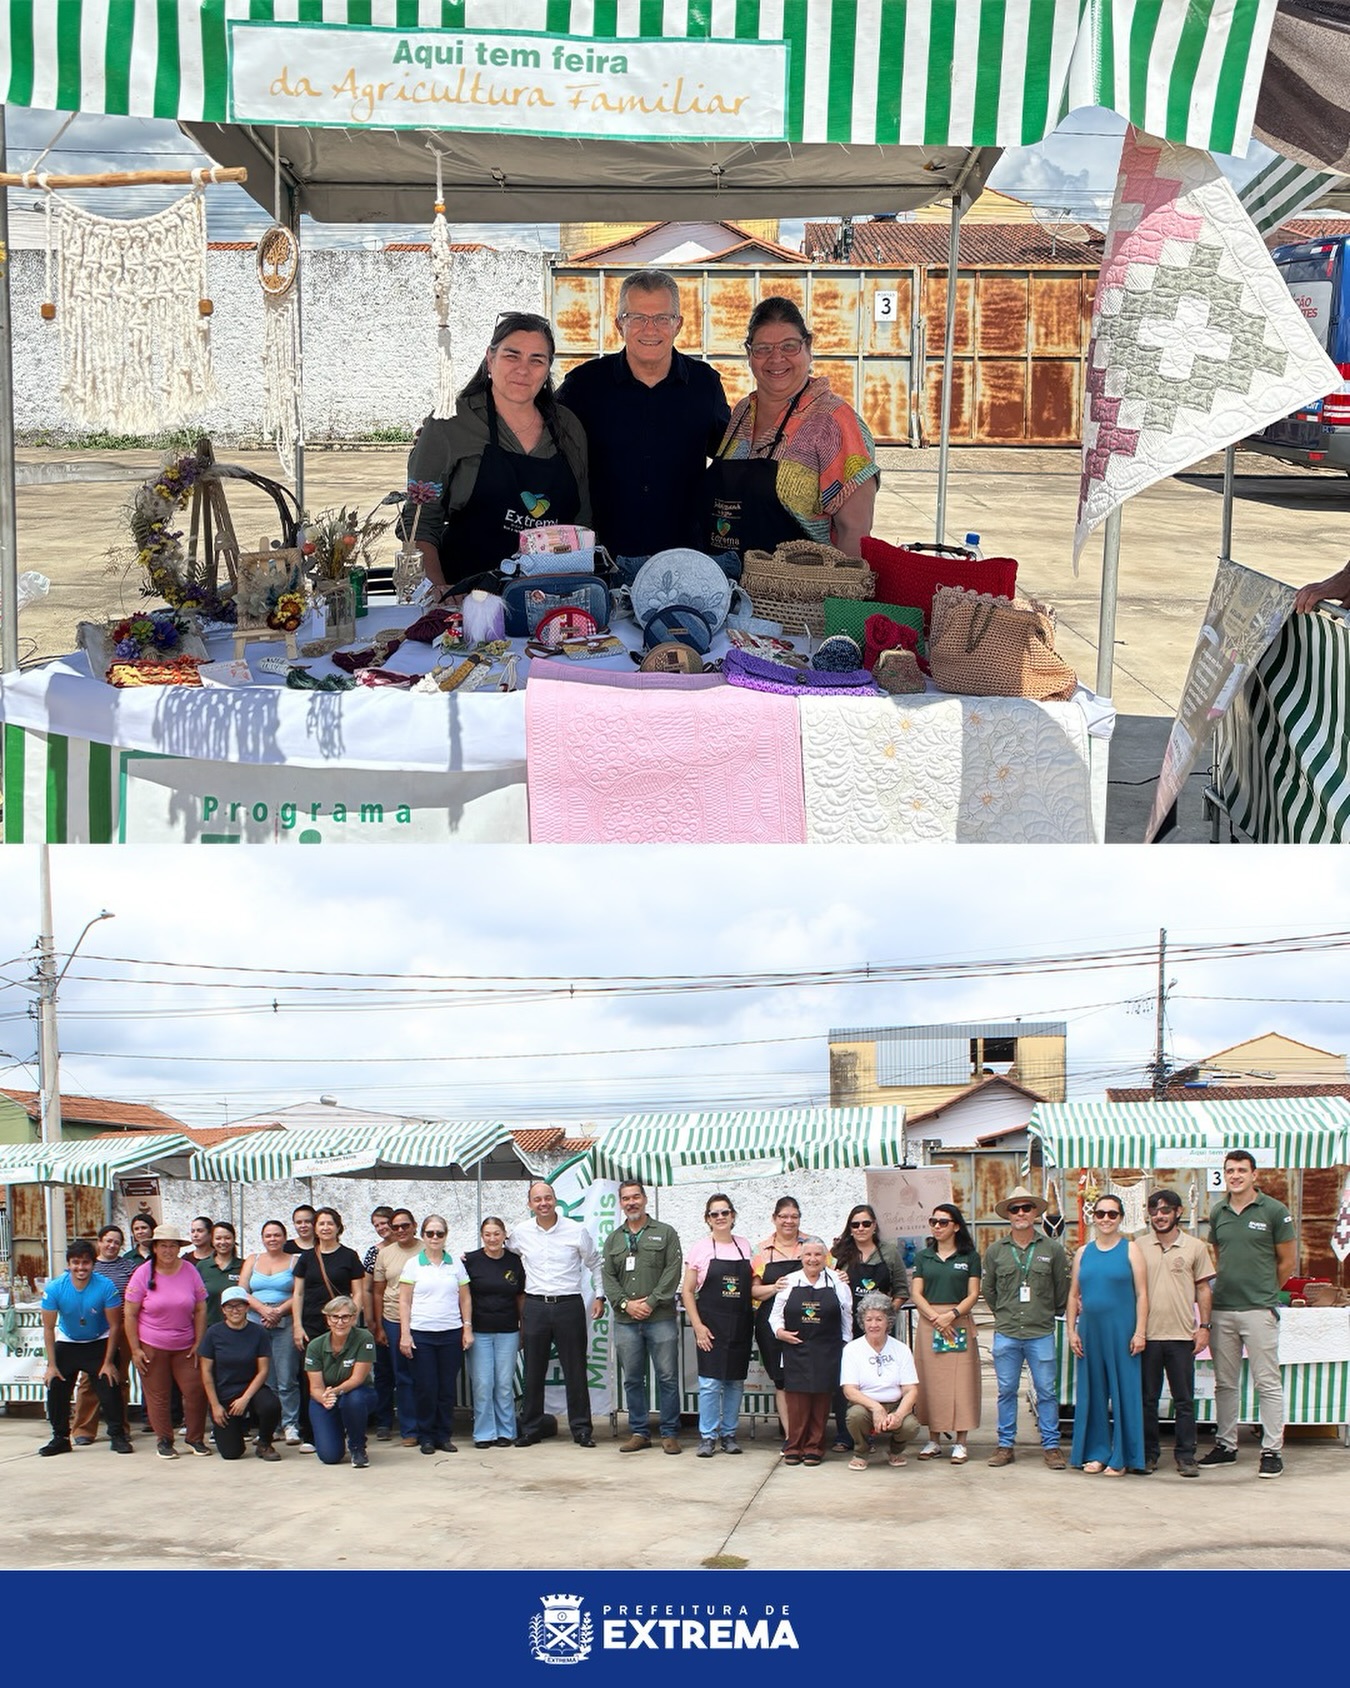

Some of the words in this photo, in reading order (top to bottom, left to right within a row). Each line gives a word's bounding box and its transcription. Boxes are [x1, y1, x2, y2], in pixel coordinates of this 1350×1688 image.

[392, 39, 464, 69] Aqui
[475, 42, 541, 68] tem
[552, 45, 628, 74] feira
[269, 65, 322, 97] da
[332, 66, 555, 122] Agricultura
[565, 77, 750, 116] Familiar
[881, 297, 891, 315] 3
[504, 508, 559, 527] Extrem
[203, 796, 412, 829] Programa
[1212, 1171, 1222, 1186] 3
